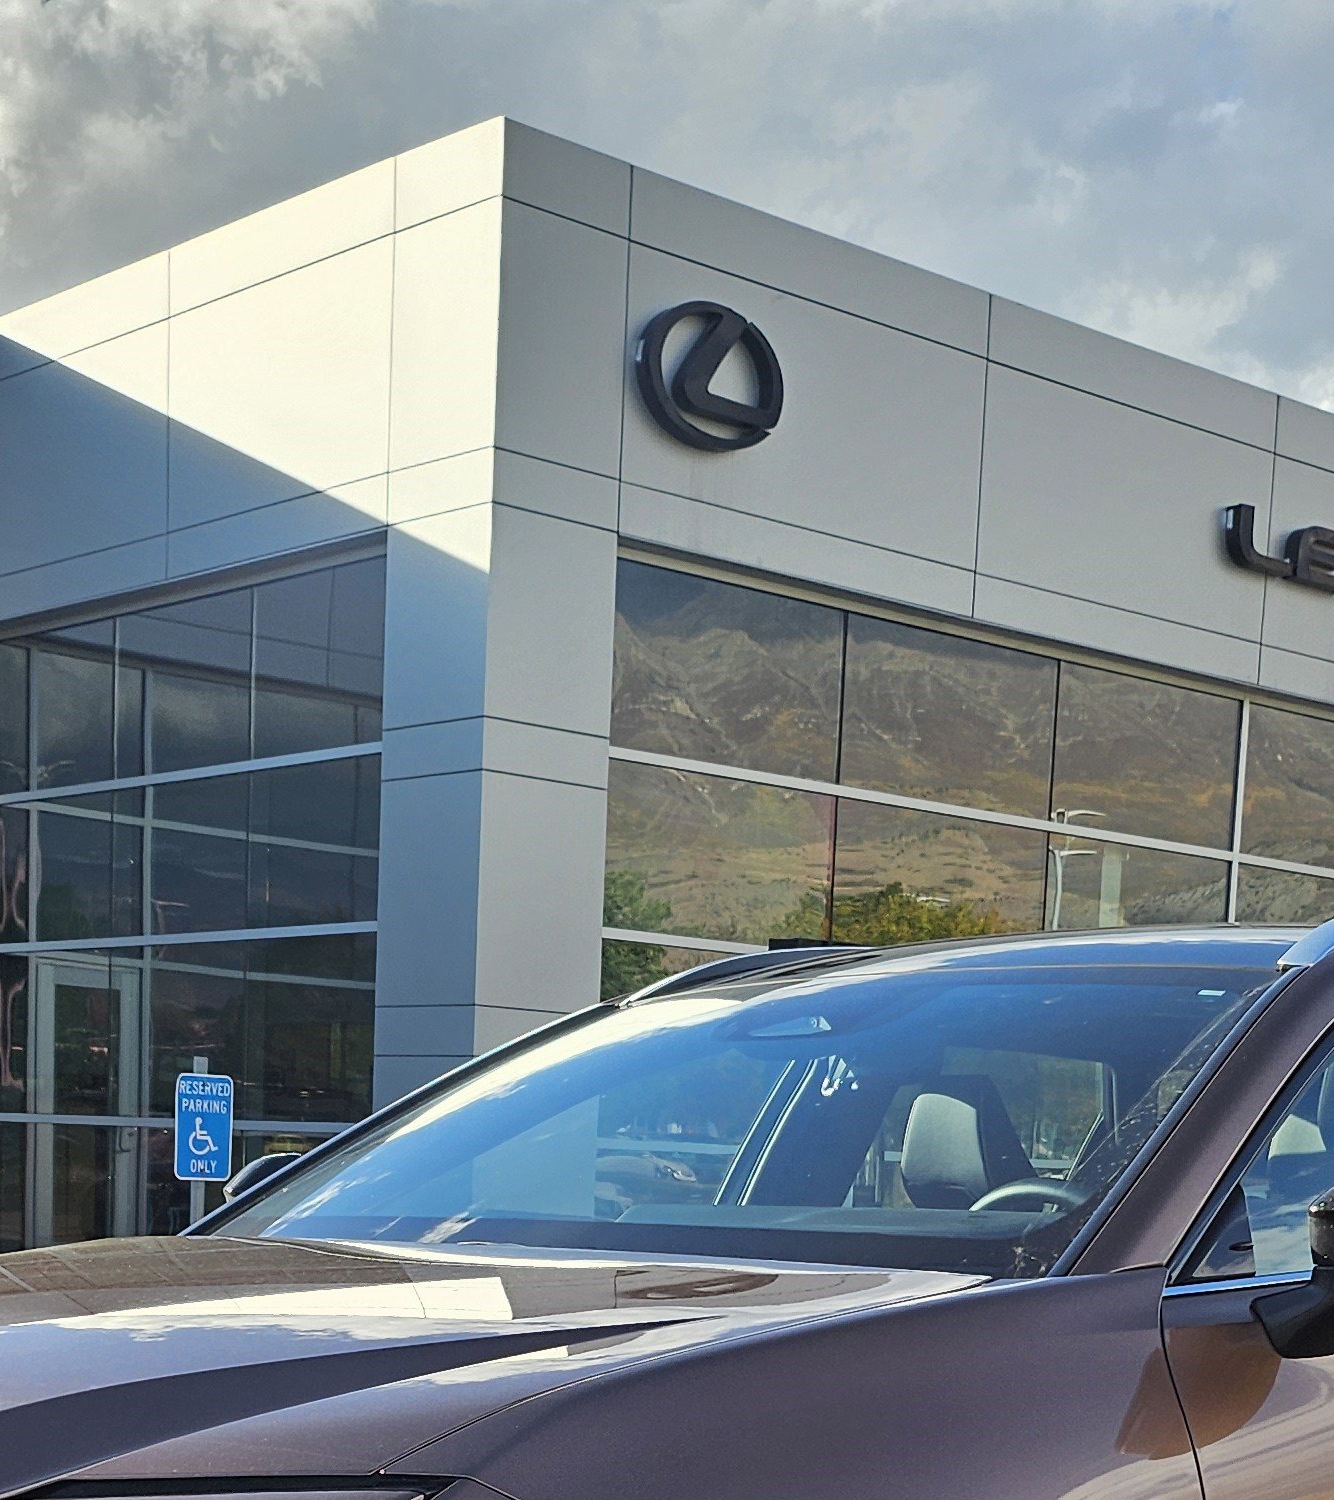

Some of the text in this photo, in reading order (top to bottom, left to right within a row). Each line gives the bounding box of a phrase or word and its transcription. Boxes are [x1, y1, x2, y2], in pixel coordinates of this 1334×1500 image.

[179, 1081, 230, 1096] RESERVED
[182, 1099, 227, 1114] PARKING
[190, 1159, 217, 1174] ONLY
